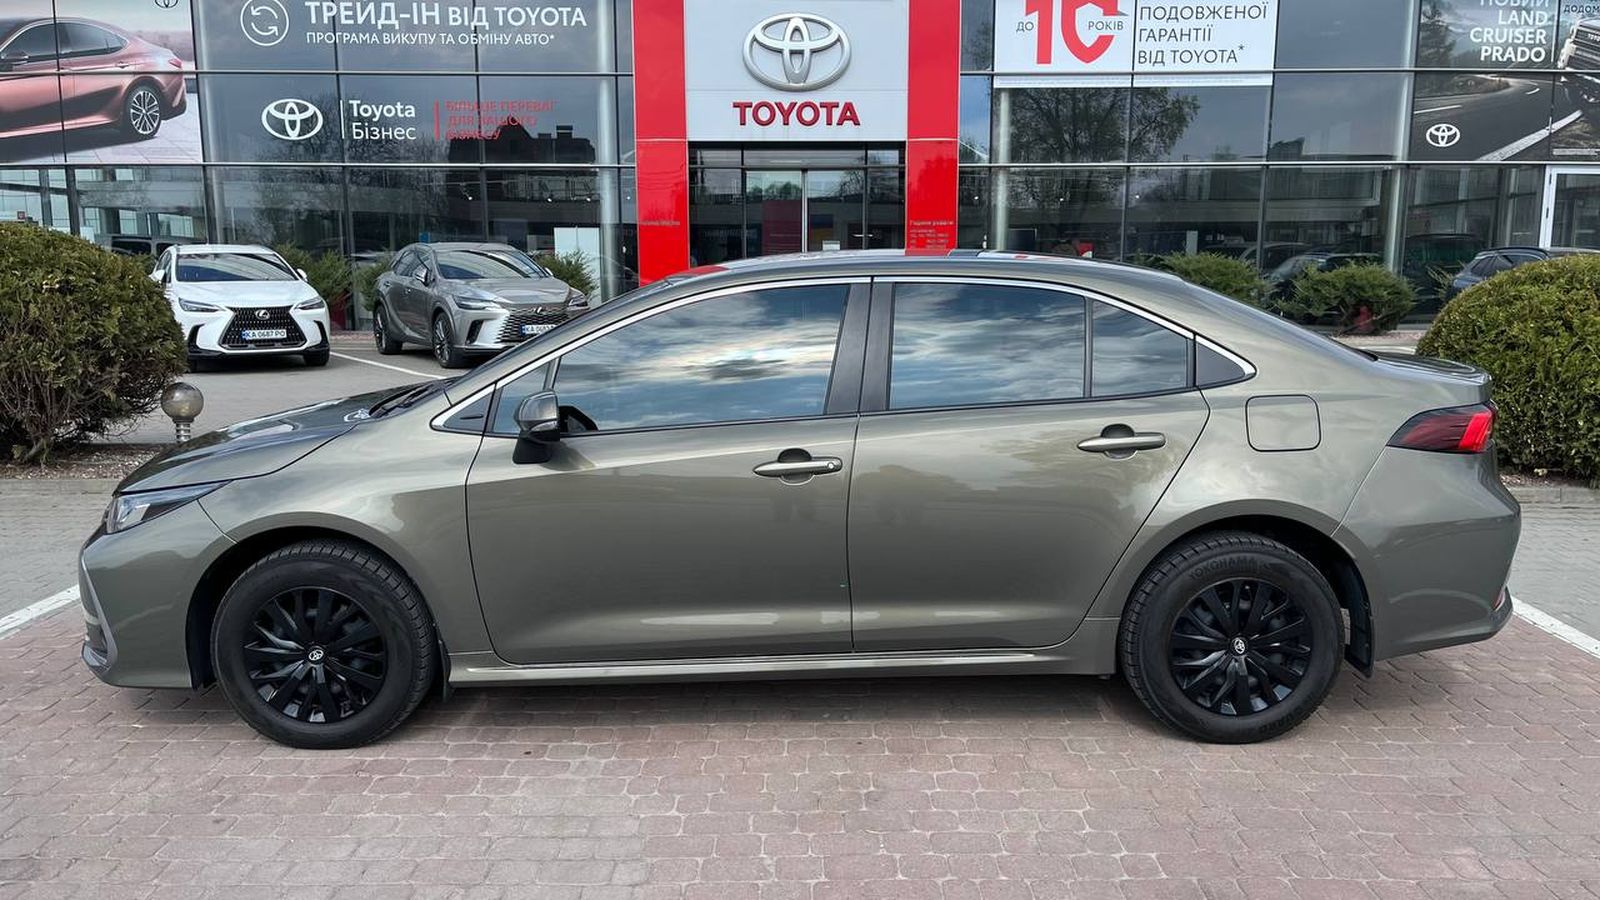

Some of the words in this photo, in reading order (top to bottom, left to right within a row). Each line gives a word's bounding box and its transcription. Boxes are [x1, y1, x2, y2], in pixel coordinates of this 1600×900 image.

[448, 7, 489, 30] ВІД
[494, 7, 587, 26] TOYOTA
[1139, 2, 1269, 23] ПОДОВЖЕНОЇ
[1498, 10, 1548, 25] LAND
[1016, 22, 1034, 32] ДО
[1088, 21, 1124, 31] РОКІВ
[1139, 24, 1213, 42] ГАРАНТІЇ
[306, 32, 380, 44] ПРОГРАМА
[383, 33, 436, 44] ВИКУПУ
[440, 34, 455, 44] ТА
[458, 34, 512, 45] ОБМІНУ
[1470, 27, 1546, 44] CRUISER
[1138, 50, 1165, 66] ВІД
[1480, 45, 1546, 62] PRADO
[349, 100, 416, 121] Toyota
[733, 101, 861, 126] TOYOTA
[352, 122, 417, 140] Бізнес
